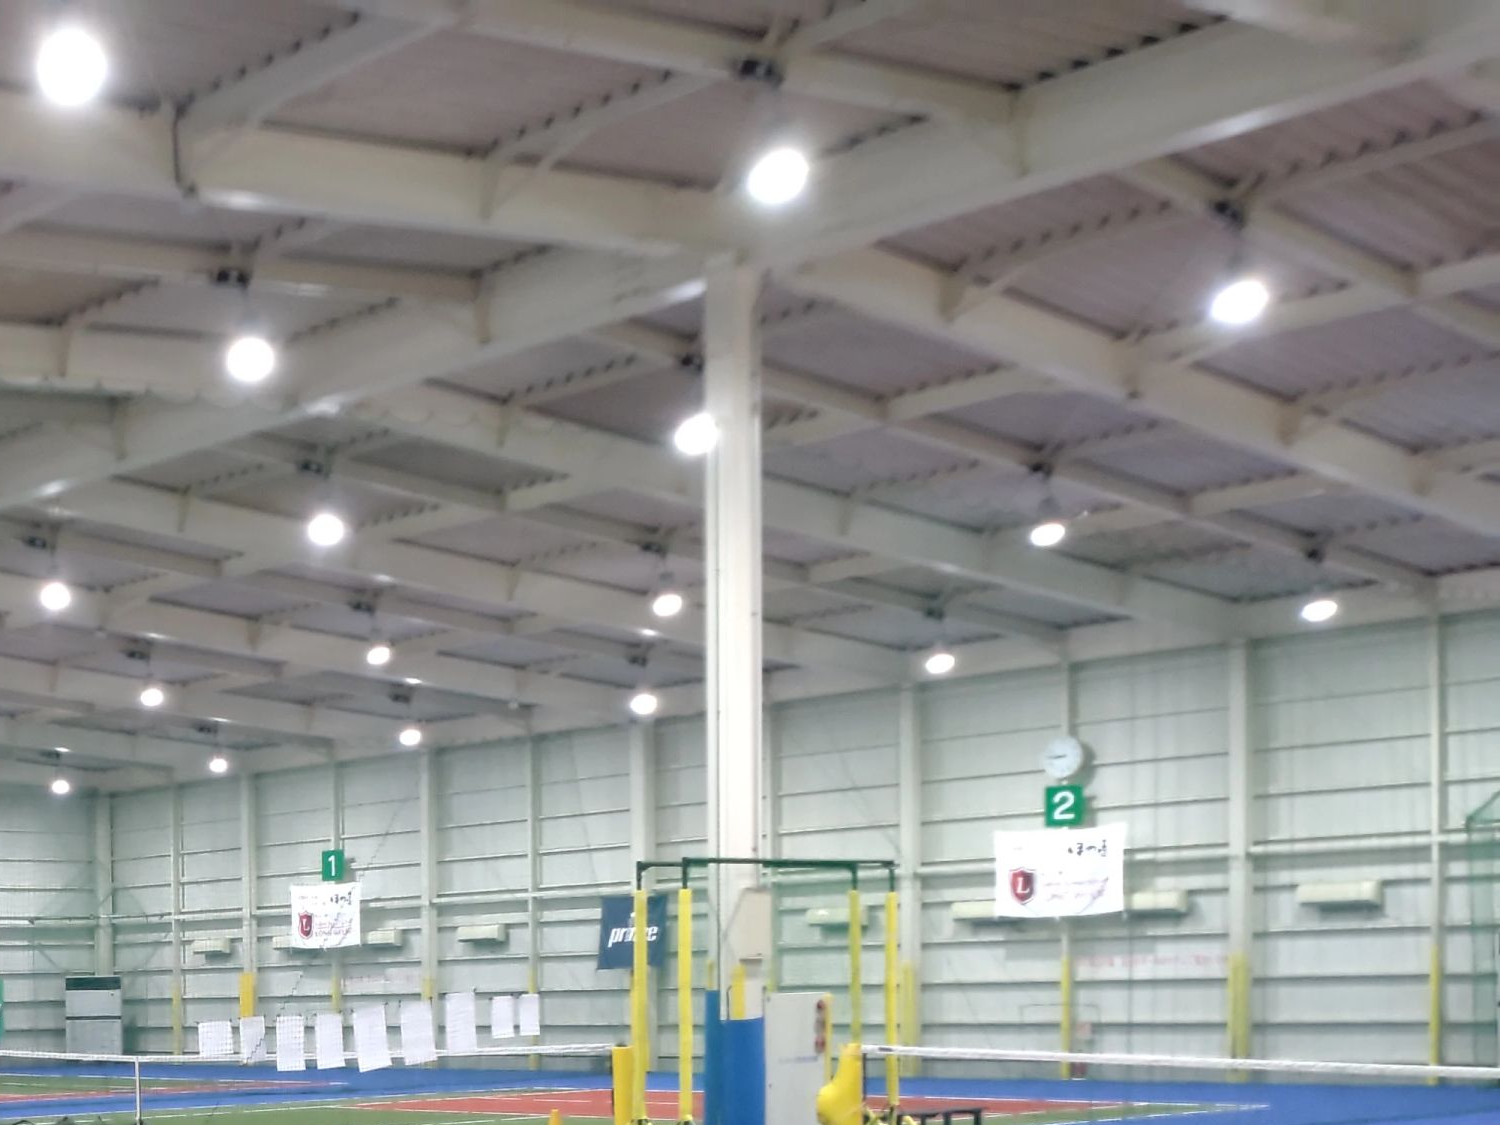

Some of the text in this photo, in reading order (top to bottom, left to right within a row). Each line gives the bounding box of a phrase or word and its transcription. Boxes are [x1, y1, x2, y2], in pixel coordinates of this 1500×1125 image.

[1052, 790, 1075, 820] 2
[328, 854, 336, 877] 1
[1015, 876, 1030, 894] L
